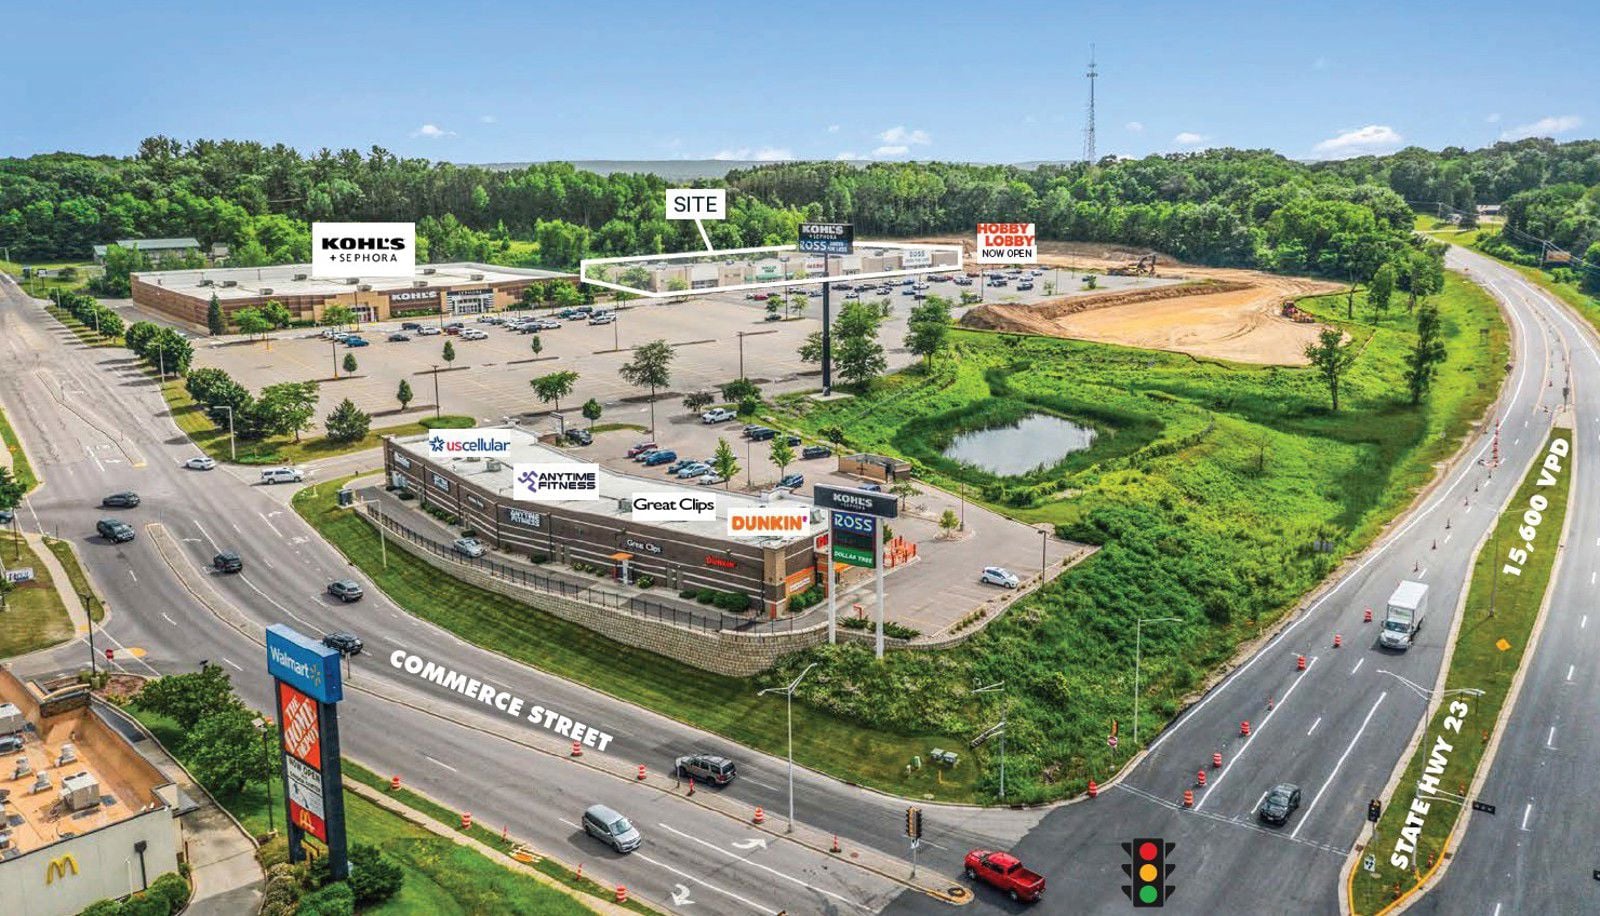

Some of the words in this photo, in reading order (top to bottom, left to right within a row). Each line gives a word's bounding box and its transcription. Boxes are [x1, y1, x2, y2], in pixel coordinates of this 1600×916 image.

[802, 225, 844, 235] KOHL'S
[834, 513, 873, 532] ROSS
[270, 646, 309, 678] Walmart
